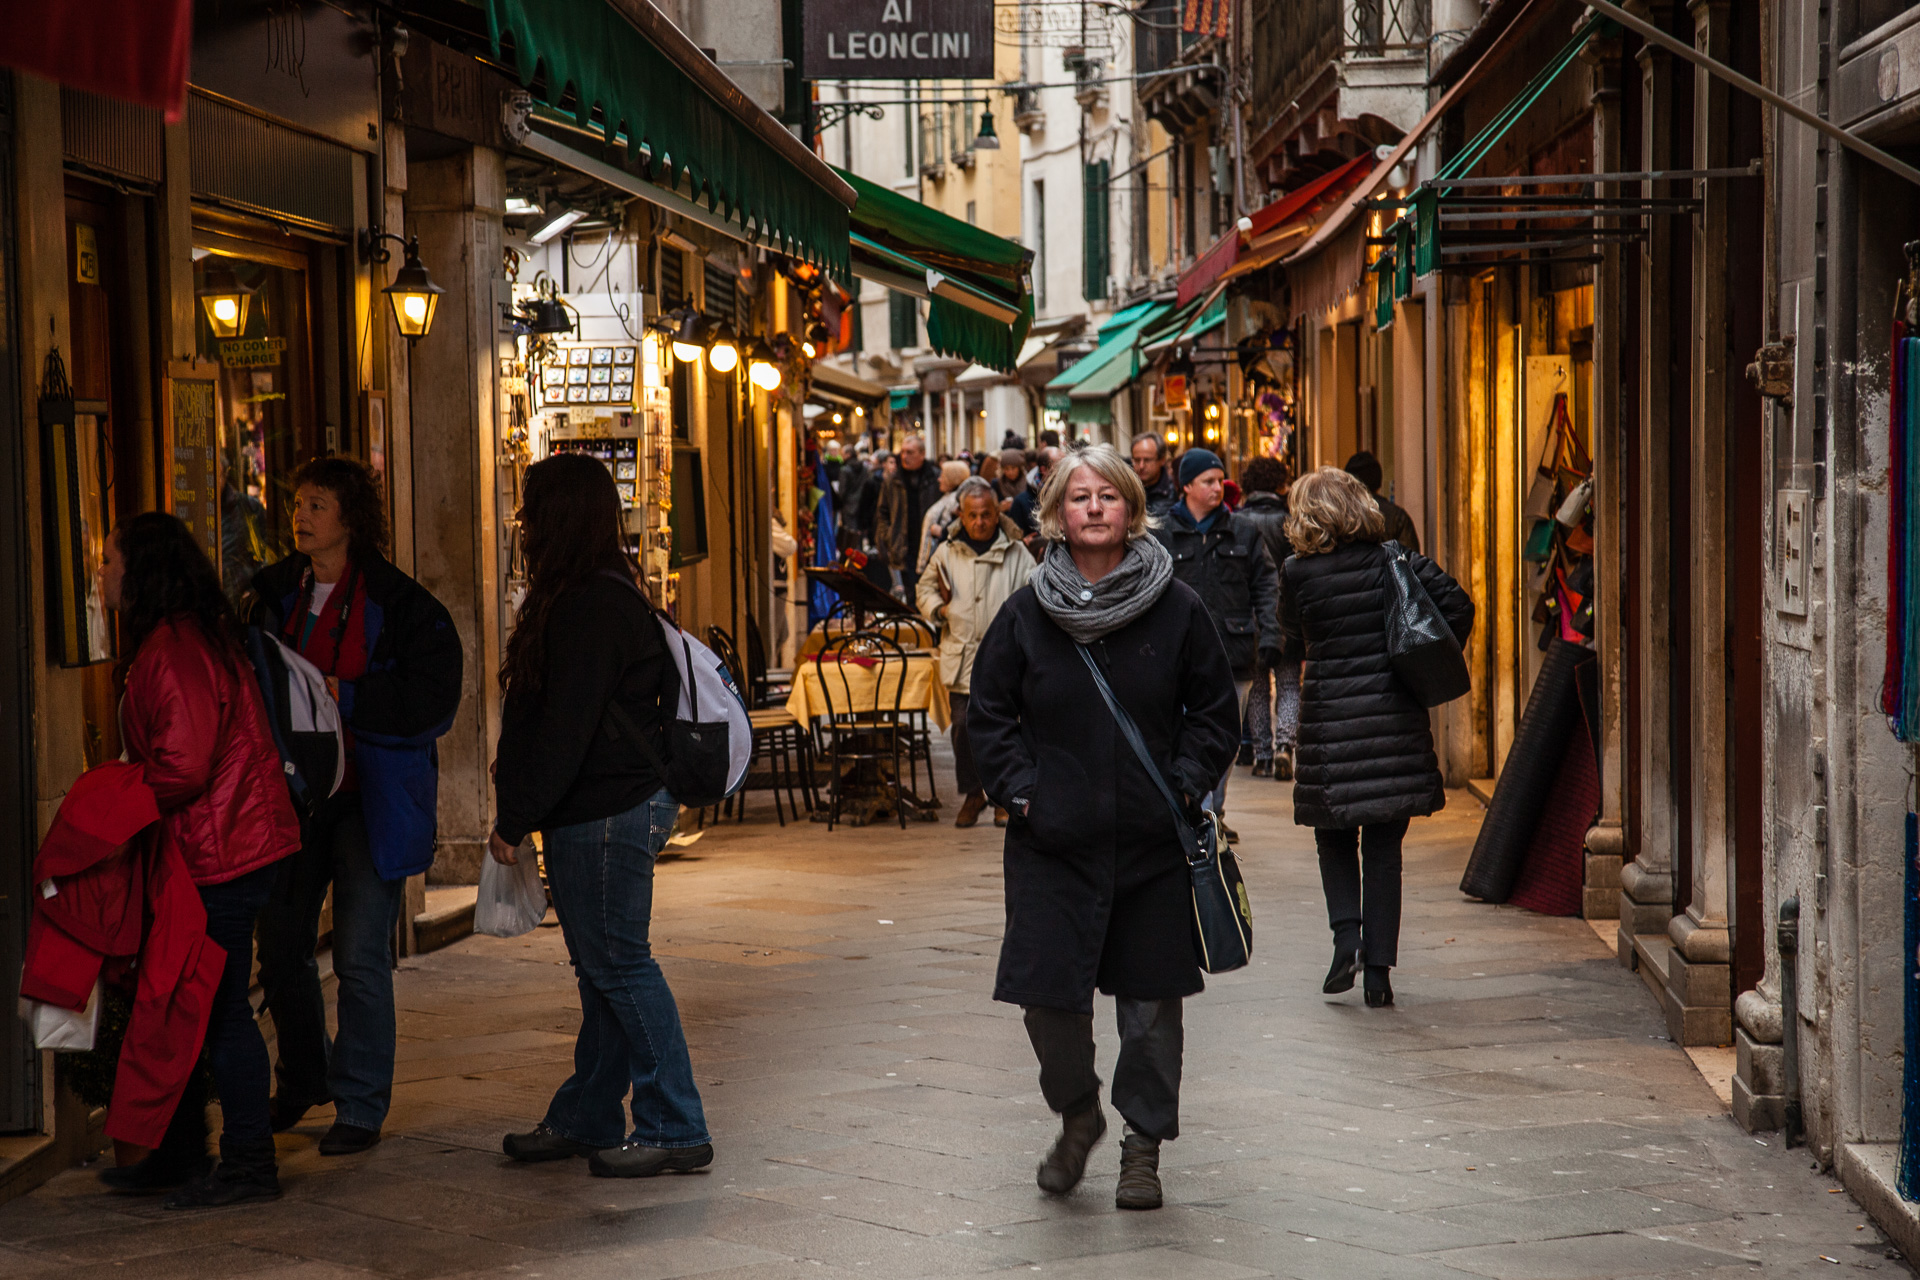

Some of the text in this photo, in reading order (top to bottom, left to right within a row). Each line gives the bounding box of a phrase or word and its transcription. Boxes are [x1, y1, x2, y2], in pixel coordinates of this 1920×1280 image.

[881, 0, 912, 23] AI
[827, 32, 969, 59] LEONCINI
[223, 339, 283, 353] NO COVER
[227, 353, 276, 366] CHARGE
[178, 416, 207, 448] PIZZA
